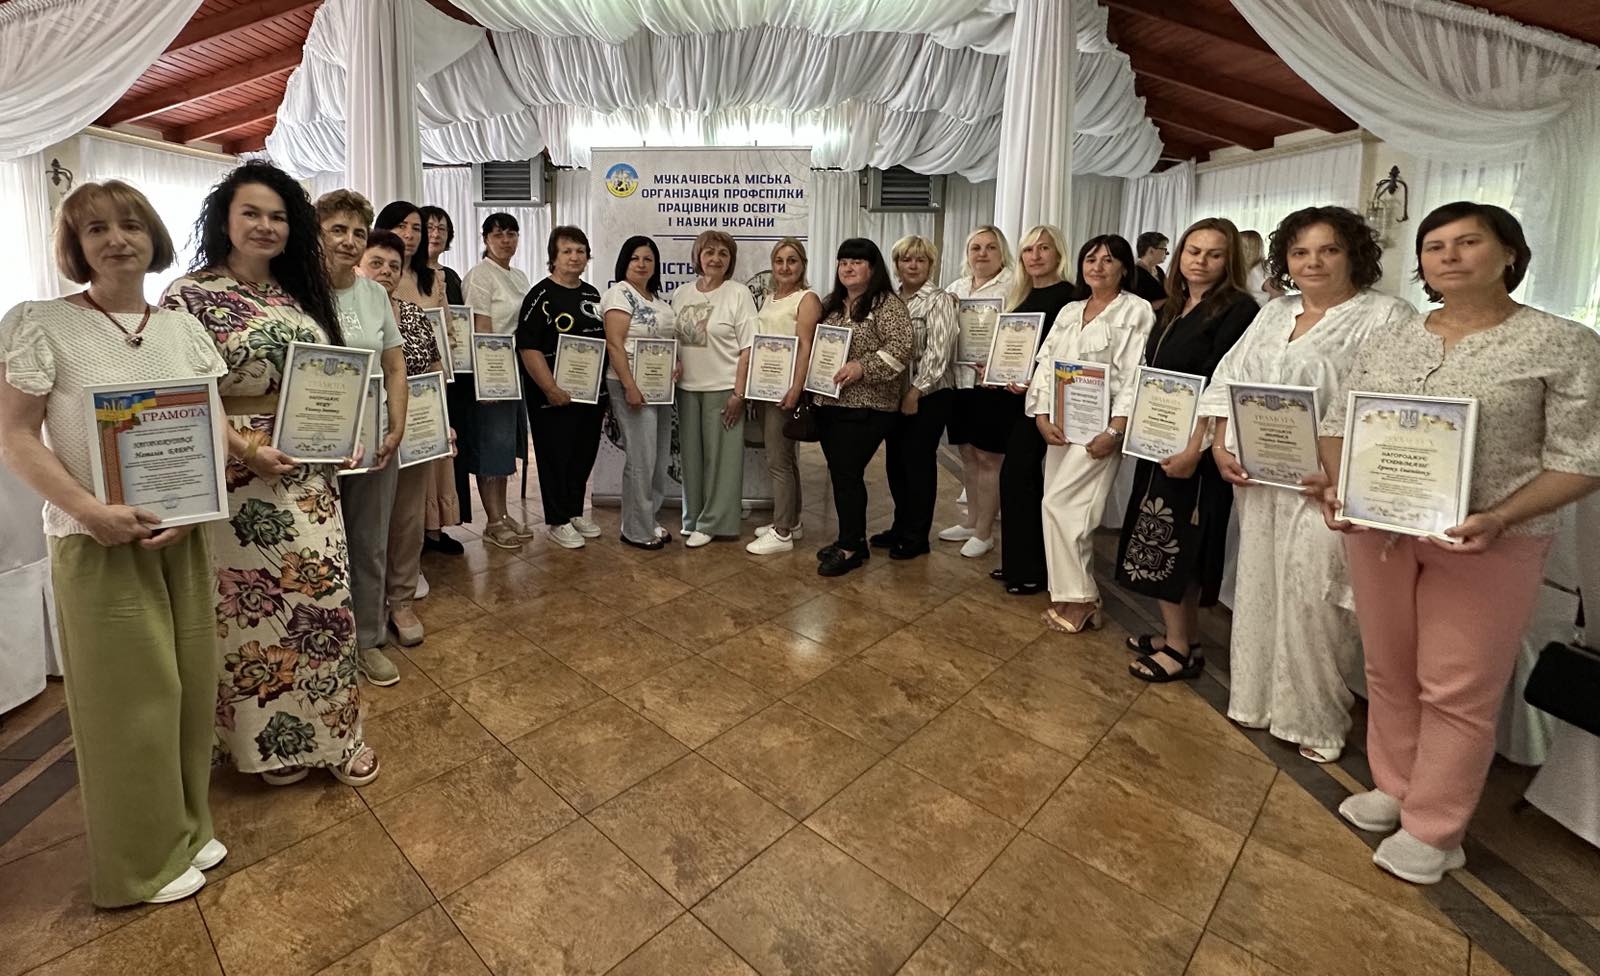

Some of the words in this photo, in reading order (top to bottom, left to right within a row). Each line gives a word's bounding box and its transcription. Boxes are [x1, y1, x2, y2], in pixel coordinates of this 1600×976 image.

[653, 174, 740, 185] МУКАЧІВСЬКА
[745, 174, 792, 185] МІСЬКА
[641, 188, 719, 200] ОРГАНІЗАЦІЯ
[724, 188, 804, 199] ПРОФСПІЛКИ
[658, 203, 739, 214] ПРАЦІВНИКІВ
[743, 203, 786, 213] ОСВІТИ
[668, 217, 672, 227] І
[676, 217, 718, 227] НАУКИ
[722, 215, 775, 227] УКРАЇНИ
[142, 408, 207, 422] ГРАМОТА
